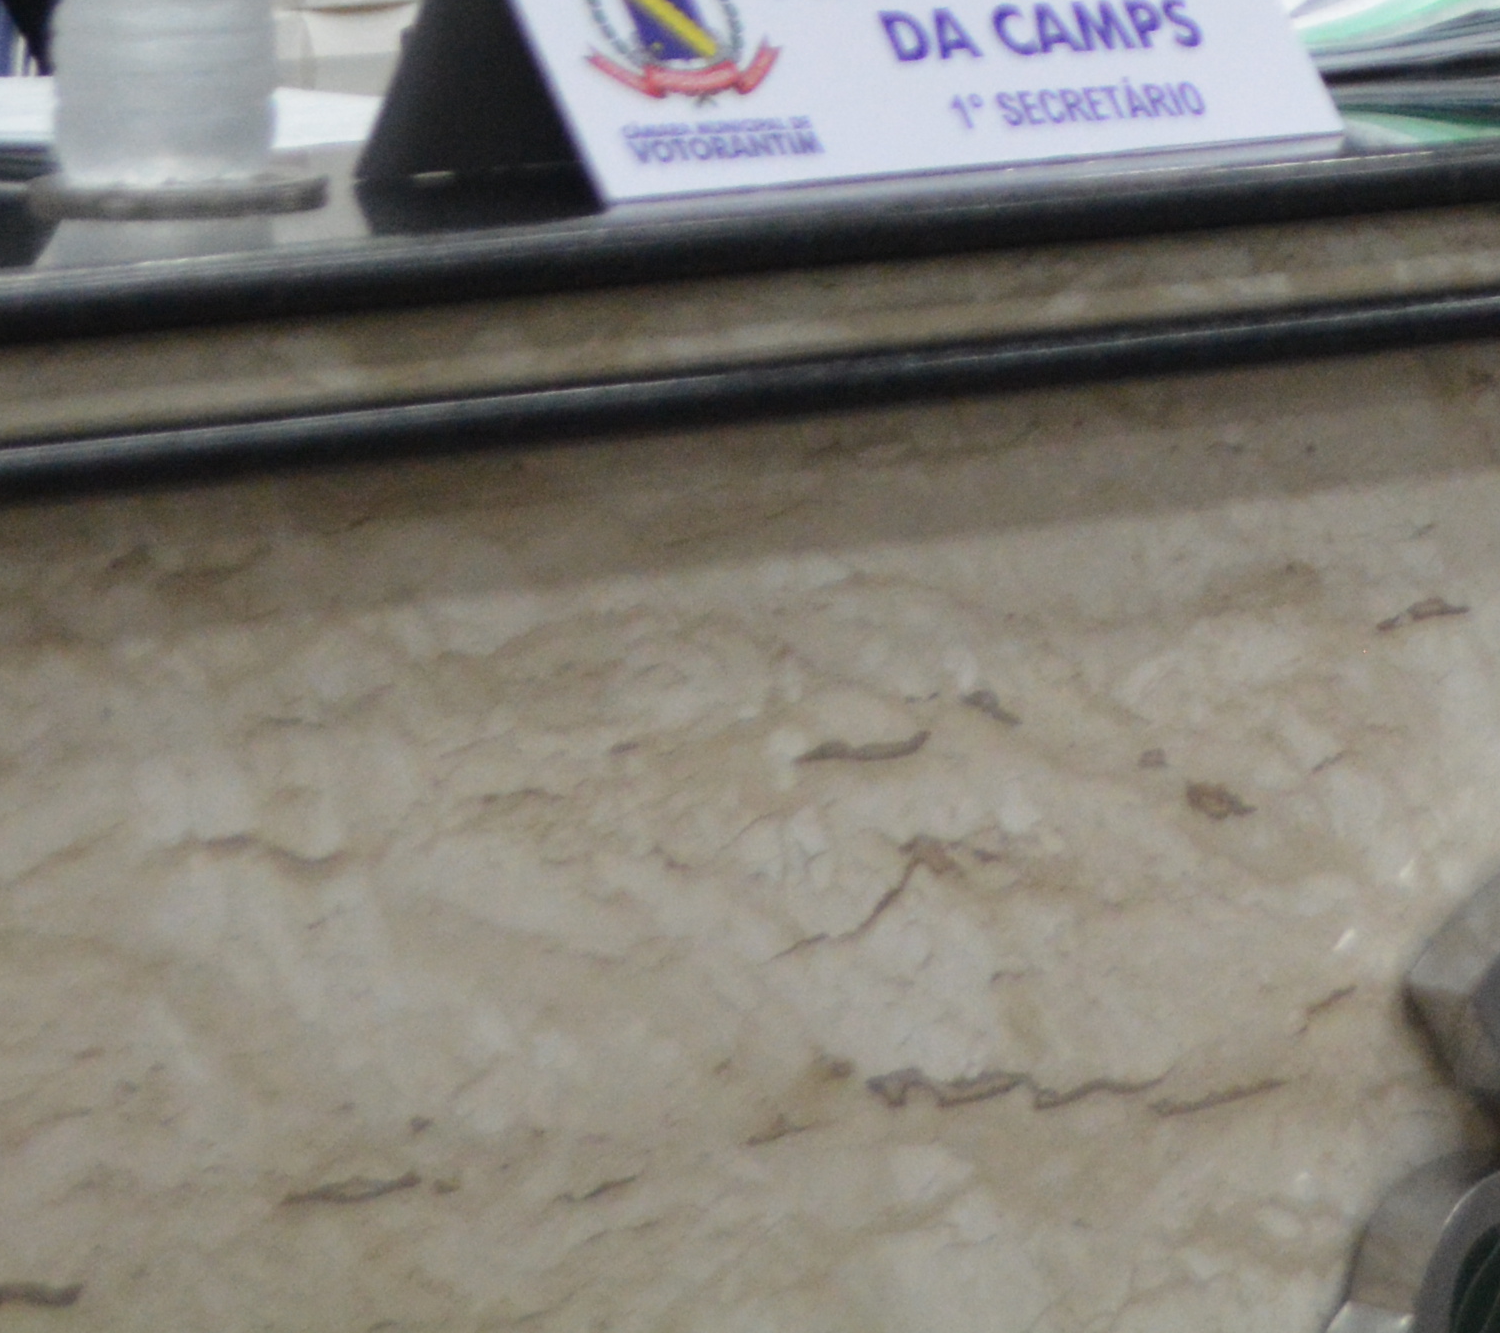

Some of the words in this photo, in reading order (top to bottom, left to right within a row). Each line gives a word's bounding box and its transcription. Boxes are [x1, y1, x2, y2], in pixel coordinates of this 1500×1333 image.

[878, 7, 984, 62] DA
[996, 76, 1206, 126] SECRETÁRIO
[627, 130, 826, 163] VOTORANTIM
